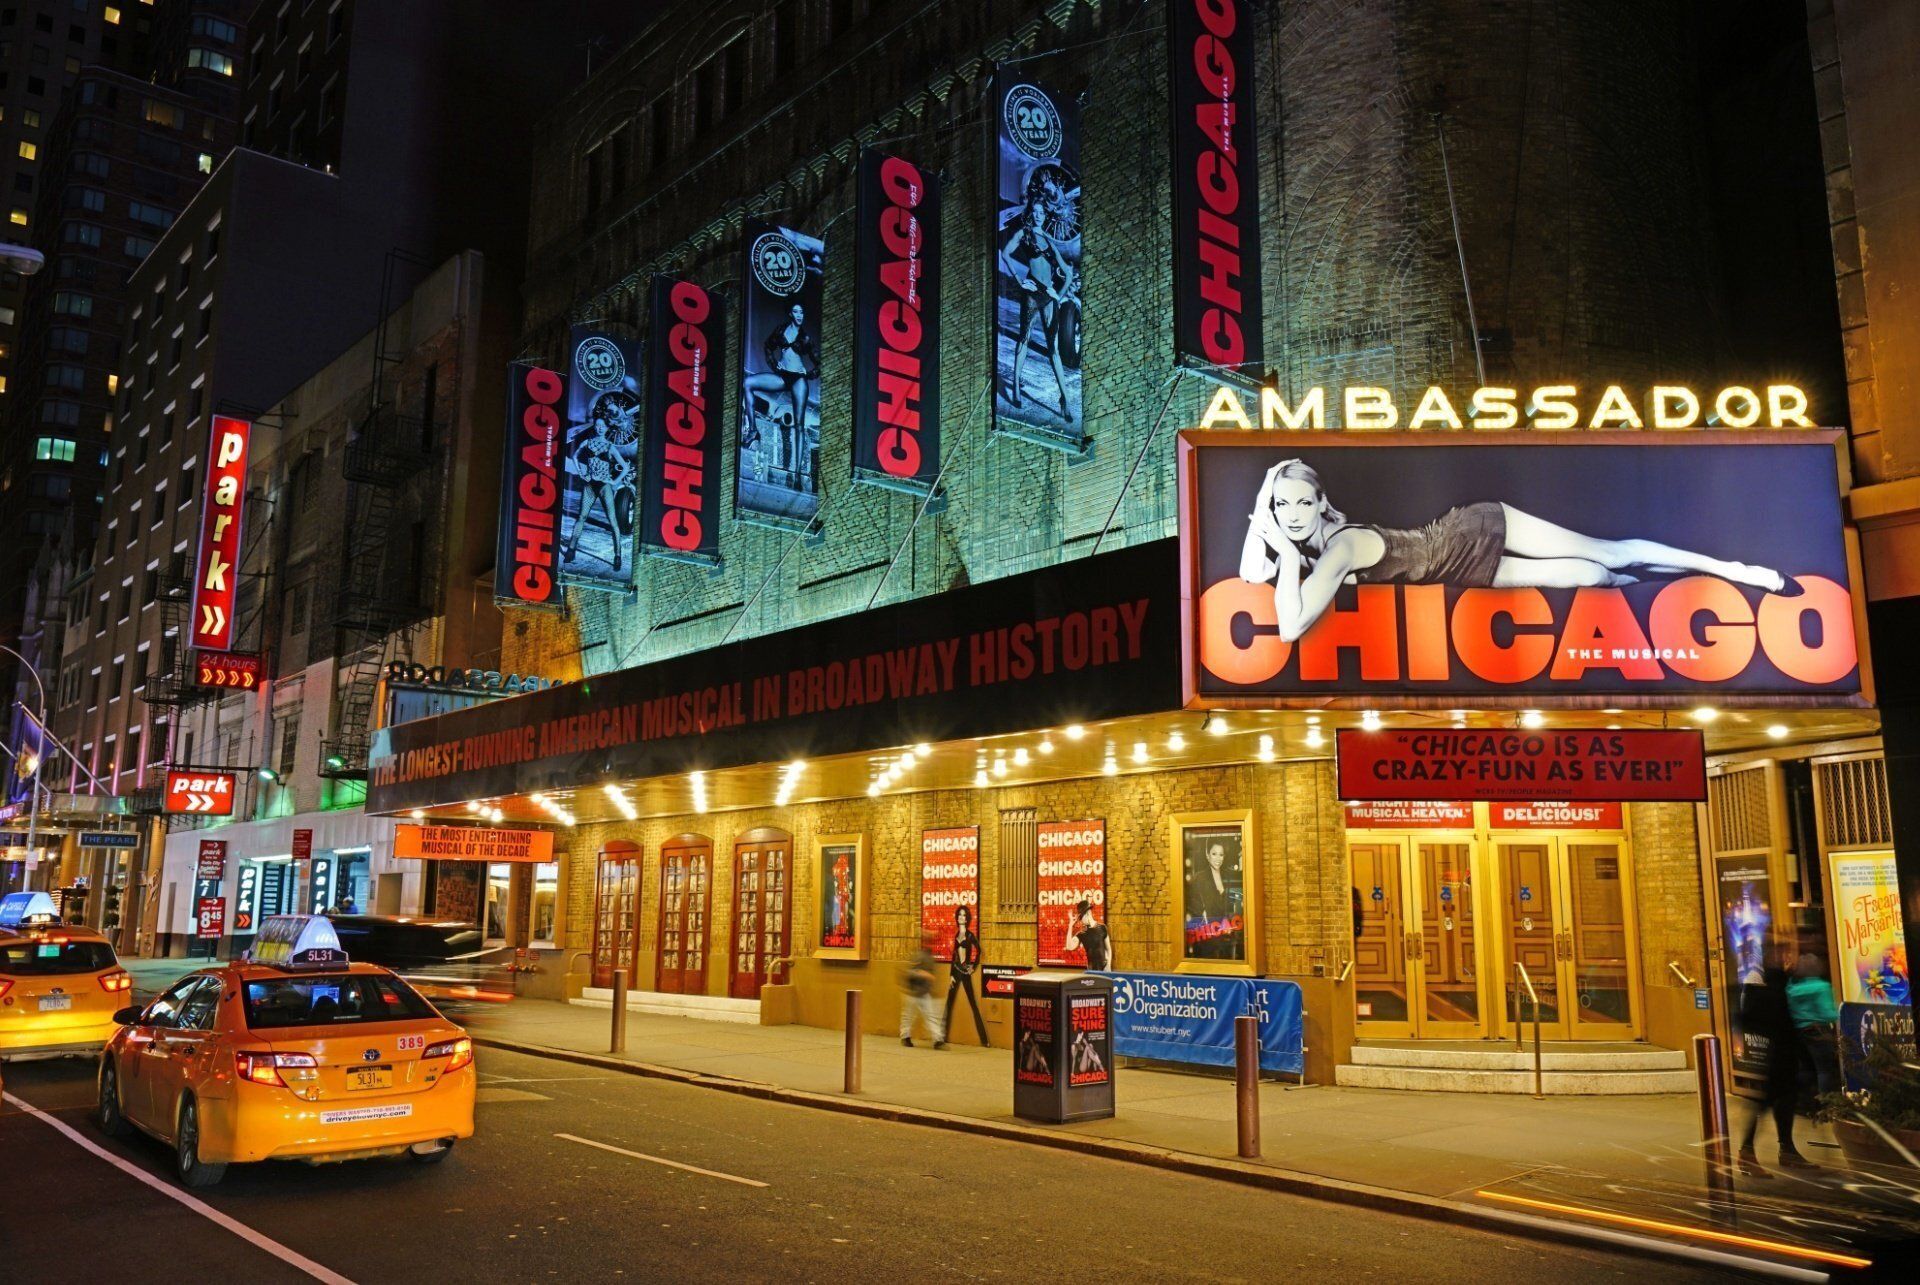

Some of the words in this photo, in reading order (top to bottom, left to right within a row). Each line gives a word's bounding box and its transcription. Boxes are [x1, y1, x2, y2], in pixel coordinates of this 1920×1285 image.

[1018, 106, 1047, 129] 20
[1022, 130, 1048, 139] YEARS
[1194, 0, 1244, 373] CHICAGO
[764, 251, 791, 270] 20
[768, 270, 792, 278] YEARS
[877, 156, 924, 478] CHICAGO
[588, 352, 612, 369] 20
[591, 367, 613, 375] YEARS
[1201, 384, 1817, 430] AMBASSADOR
[661, 280, 710, 551] CHICAGO
[513, 368, 563, 603] CHICAGO
[205, 432, 243, 591] park
[1199, 575, 1858, 684] CHICAGO
[201, 654, 218, 666] 24
[222, 656, 257, 670] hours
[1567, 649, 1603, 660] THE
[1612, 649, 1700, 660] MUSICAL
[374, 755, 396, 787] THE
[399, 725, 535, 782] LONGEST-RUNNING
[539, 704, 637, 756] AMERICAN
[642, 682, 745, 741] MUSICAL
[753, 674, 781, 720] IN
[787, 638, 960, 716] BROADWAY
[969, 599, 1150, 687] HISTORY
[1397, 735, 1544, 757] “CHICAGO
[1555, 735, 1581, 757] IS
[1589, 735, 1625, 757] AS
[1373, 759, 1536, 782] CRAZY-FUN
[1547, 760, 1583, 781] AS
[172, 777, 230, 794] park
[1352, 808, 1409, 818] MUSICAL
[421, 827, 438, 840] THE
[440, 828, 467, 842] MOST
[469, 830, 532, 844] ENTERTAINING
[1038, 829, 1104, 848] CHICAGO
[421, 841, 463, 854] MUSICAL
[466, 843, 477, 855] OF
[479, 844, 494, 856] THE
[497, 844, 530, 857] DECADE
[923, 836, 977, 852] CHICAGO
[923, 864, 977, 879] CHICAGO
[1038, 860, 1104, 876] CHICAGO
[239, 868, 255, 911] park
[314, 861, 327, 915] park
[922, 890, 977, 906] CHICAGO
[1038, 889, 1104, 905] CHICAGO
[308, 950, 333, 961] 5L31
[1133, 979, 1159, 998] The
[1161, 980, 1217, 1001] Shubert
[1020, 998, 1052, 1008] BROADWAY'S
[1071, 998, 1105, 1008] BROADWAY'S
[1133, 997, 1217, 1020] Organization
[1020, 1008, 1051, 1020] SURE
[1072, 1006, 1105, 1020] SURE
[1021, 1020, 1052, 1032] THING
[1072, 1019, 1105, 1032] THING
[1131, 1023, 1191, 1037] www.shubert.nyc
[400, 1036, 424, 1050] 389
[1018, 1069, 1053, 1084] CHICAGO
[1070, 1070, 1107, 1083] CHICAGO
